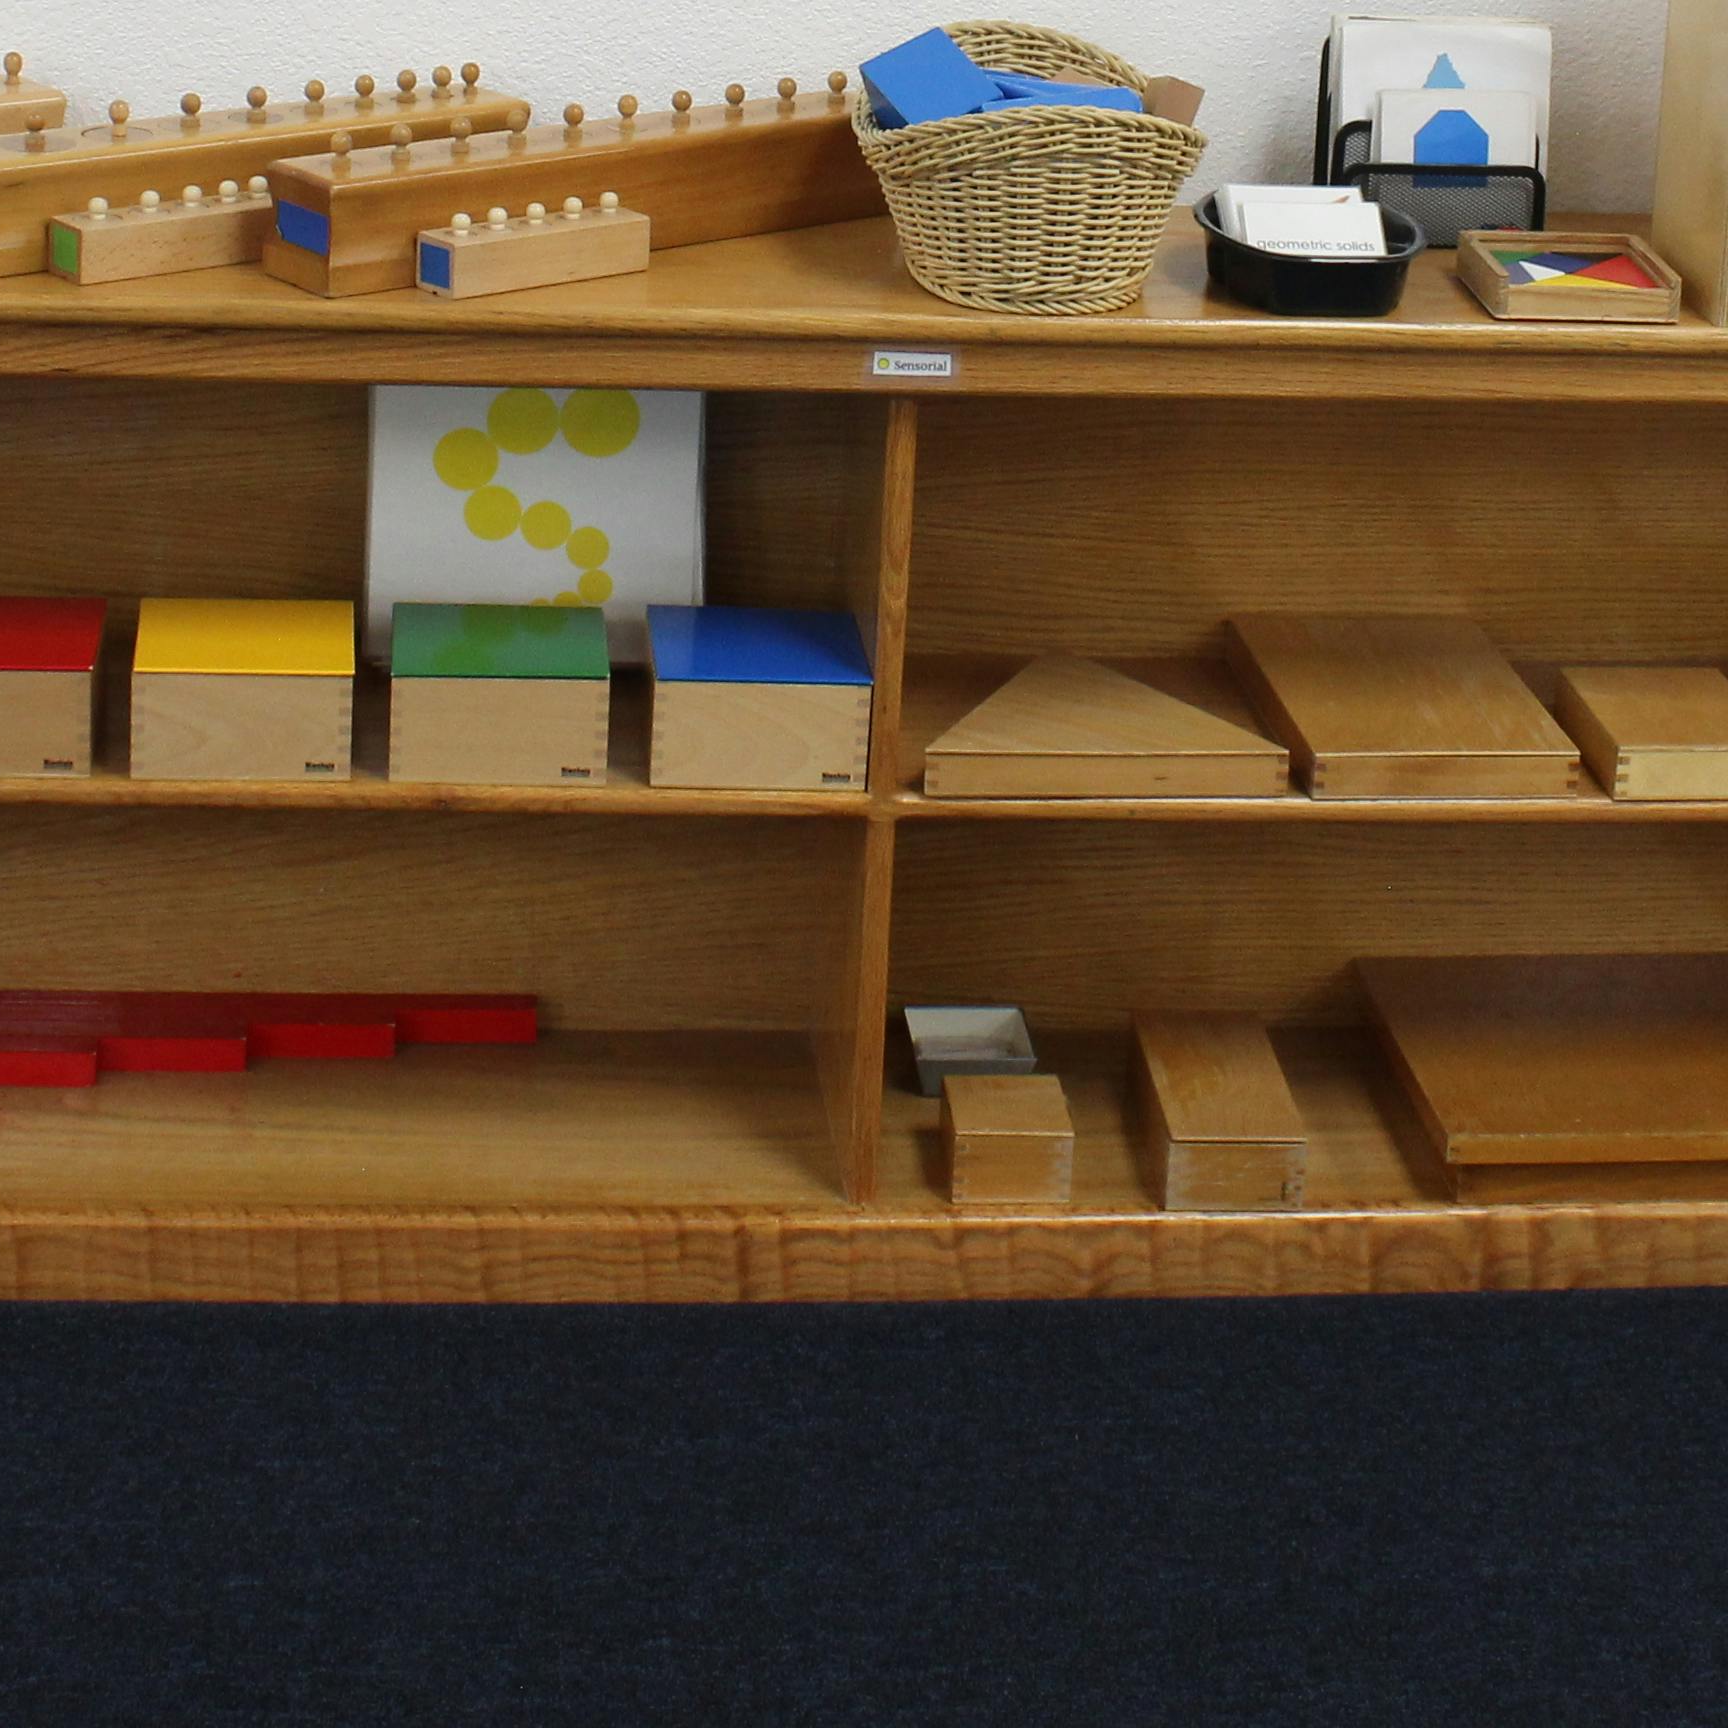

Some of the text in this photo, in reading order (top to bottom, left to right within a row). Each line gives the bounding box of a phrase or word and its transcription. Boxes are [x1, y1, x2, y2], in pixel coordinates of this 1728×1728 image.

[1257, 238, 1376, 253] geometric solids
[894, 359, 948, 372] Sensorial
